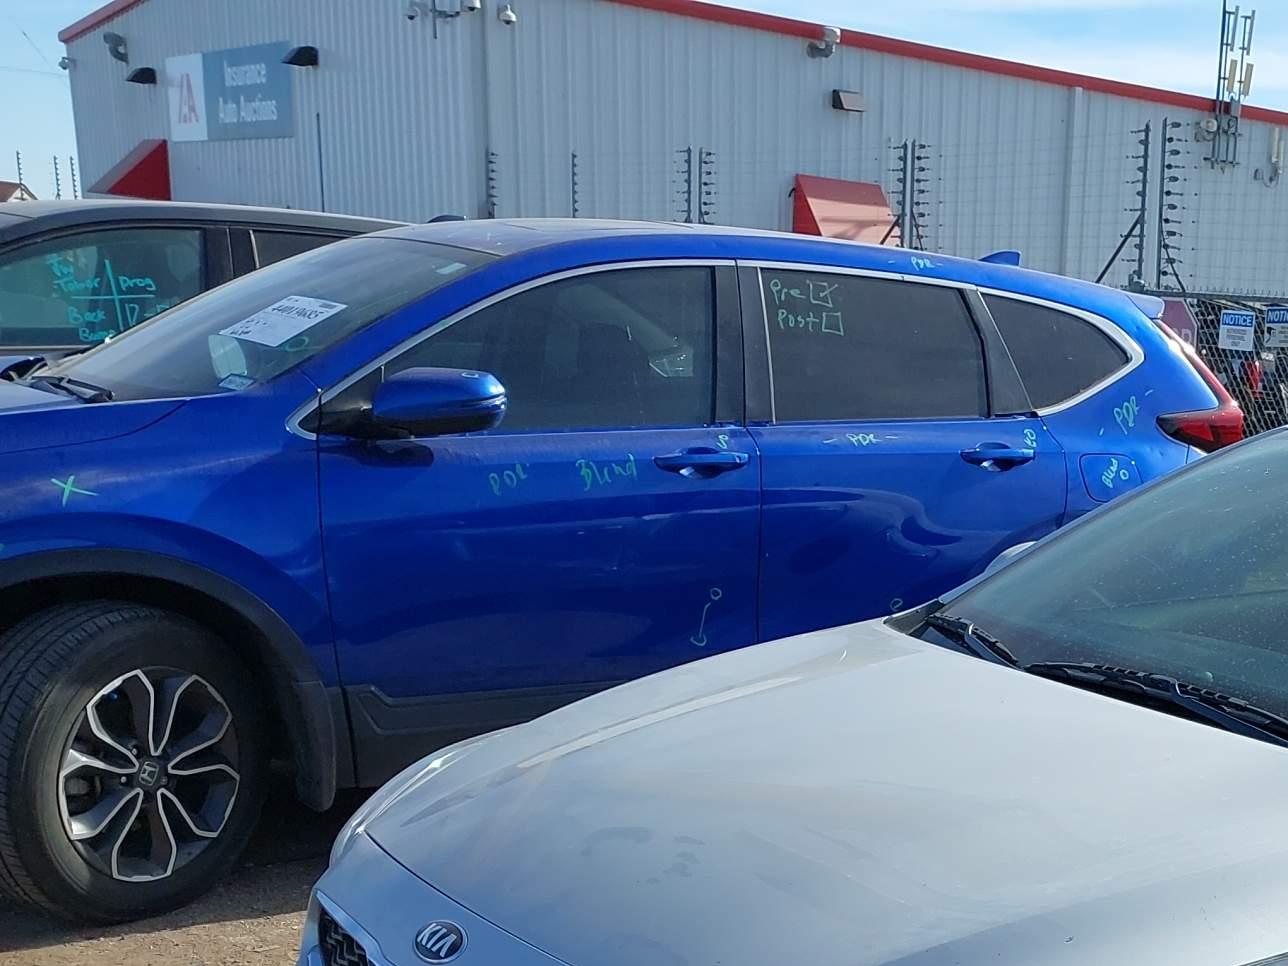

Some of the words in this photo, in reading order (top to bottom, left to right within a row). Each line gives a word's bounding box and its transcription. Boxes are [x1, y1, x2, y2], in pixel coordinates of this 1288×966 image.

[223, 60, 267, 87] Insurance
[219, 96, 237, 123] Auto
[240, 93, 278, 122] Auctions
[770, 279, 806, 304] Pre
[777, 309, 819, 331] Post
[1222, 313, 1254, 327] NOTICE
[416, 922, 458, 958] KIA
